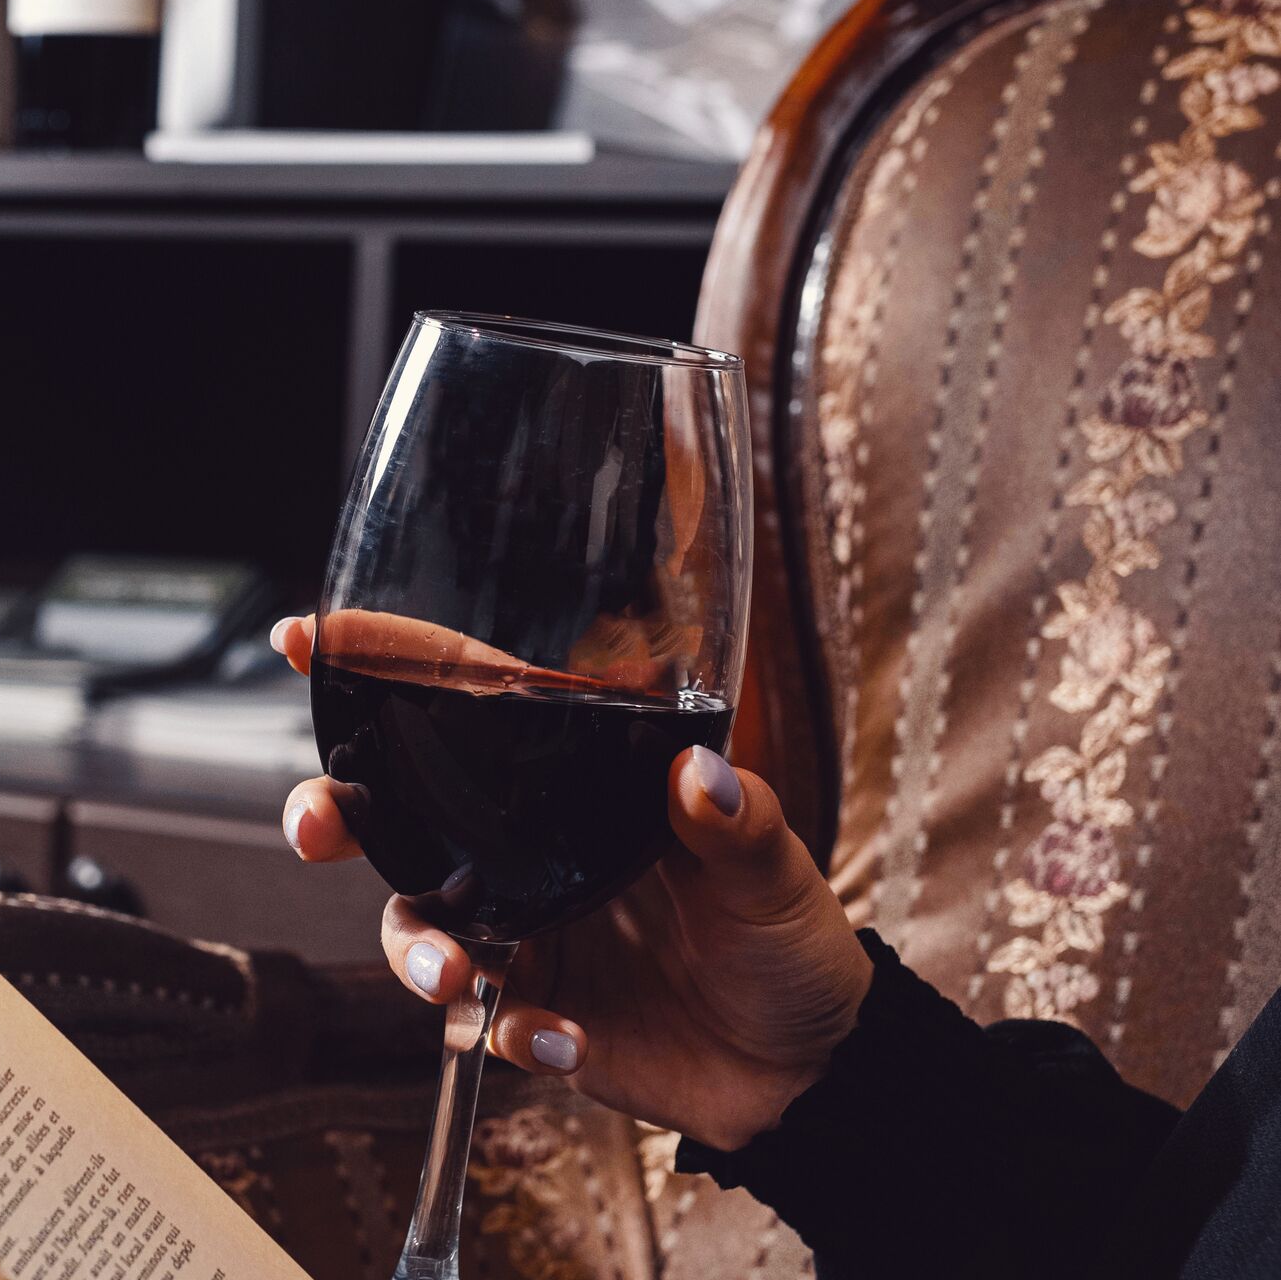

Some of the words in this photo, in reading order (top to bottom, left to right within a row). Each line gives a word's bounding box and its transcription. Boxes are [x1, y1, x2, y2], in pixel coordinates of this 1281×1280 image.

[11, 1109, 35, 1138] mise
[31, 1096, 47, 1113] en
[7, 1152, 29, 1175] des
[24, 1122, 52, 1156] allées
[48, 1109, 62, 1126] et
[38, 1124, 77, 1168] laquelle
[96, 1182, 110, 1199] ce
[101, 1166, 122, 1188] fut
[10, 1205, 67, 1278] ambulanciers
[62, 1152, 107, 1209] allèrent-ils
[76, 1205, 122, 1259] Jusque-là,
[115, 1181, 137, 1207] rien
[87, 1193, 102, 1211] et
[50, 1204, 94, 1256] l'hôpital,
[89, 1247, 114, 1280] avait
[110, 1230, 127, 1250] un
[123, 1195, 152, 1232] match
[118, 1236, 147, 1269] local
[141, 1209, 167, 1244] avant
[164, 1222, 182, 1247] qui
[42, 1250, 60, 1269] de
[170, 1238, 197, 1272] dépôt
